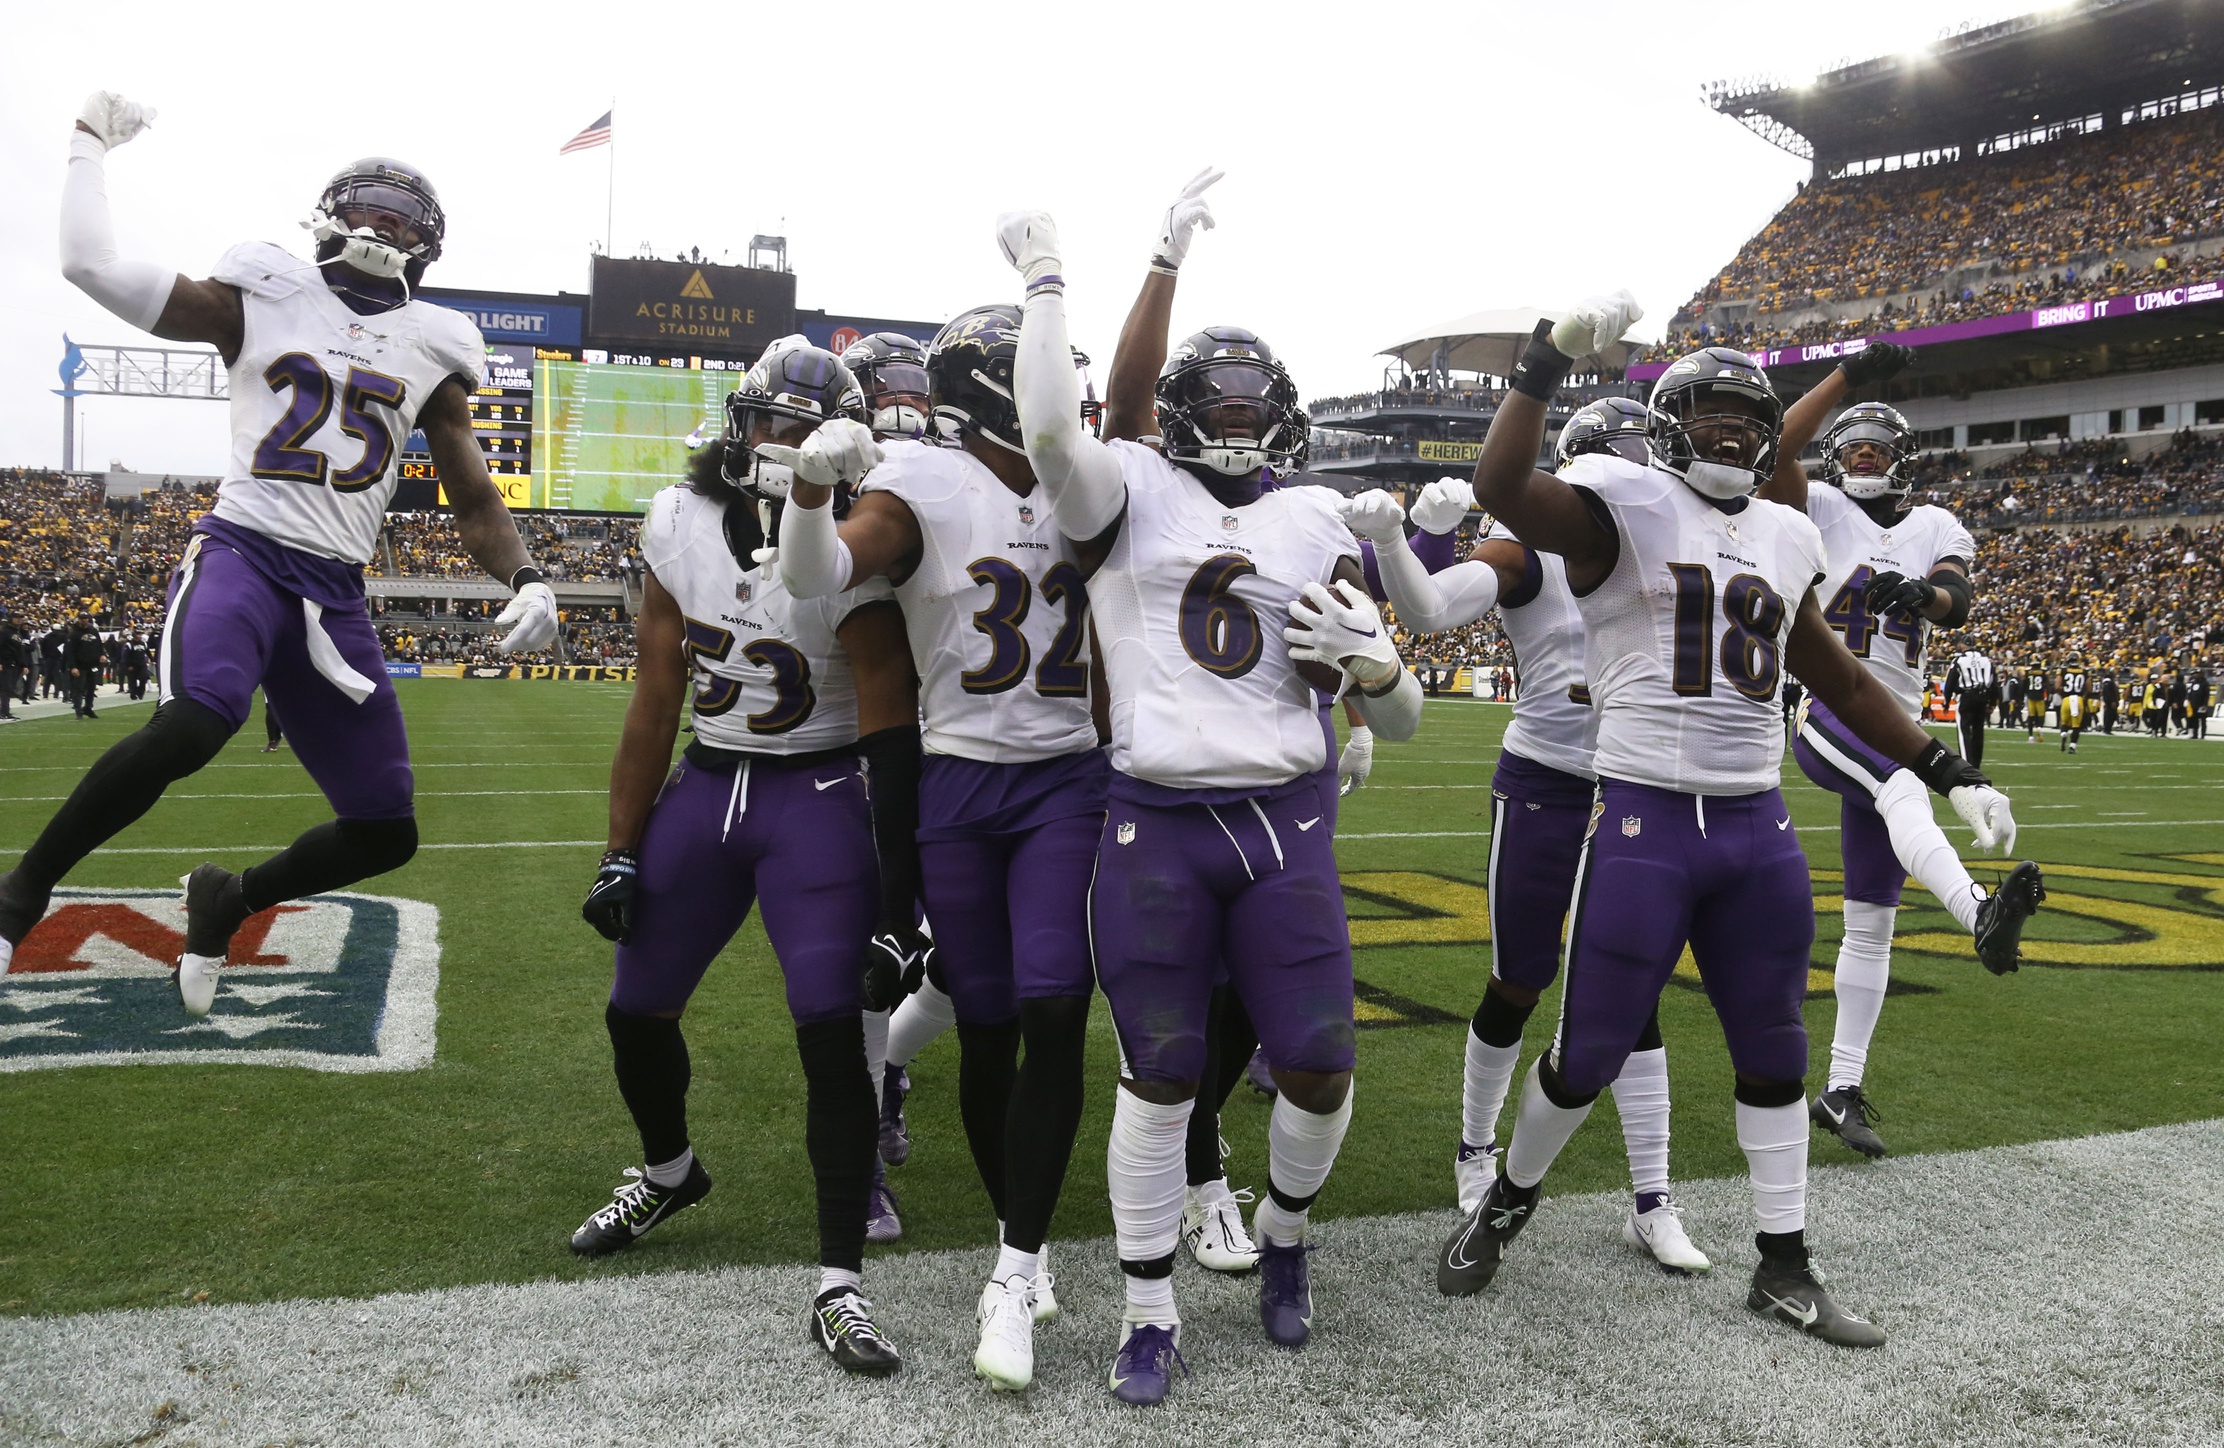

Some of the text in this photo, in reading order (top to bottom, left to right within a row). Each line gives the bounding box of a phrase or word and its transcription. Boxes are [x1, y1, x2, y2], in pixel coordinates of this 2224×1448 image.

[636, 302, 755, 324] ACRISURE
[2038, 288, 2183, 326] BRING IT UPMC
[481, 312, 544, 332] LIGHT
[659, 322, 730, 337] STADIUM
[835, 334, 858, 353] 84
[1802, 342, 1840, 361] UPMC
[328, 349, 371, 366] RAVENS
[536, 349, 571, 361] Steelers
[1769, 351, 1781, 365] IT
[671, 357, 684, 367] 23
[704, 360, 725, 370] 2ND
[728, 361, 745, 370] 0:21
[494, 368, 528, 378] GAME
[490, 377, 532, 388] LEADERS
[475, 388, 503, 397] ASSING
[251, 352, 406, 493] 25
[403, 463, 435, 478] 0:21
[1007, 541, 1049, 551] RAVENS
[1205, 543, 1252, 555] RAVENS
[1717, 552, 1757, 568] RAVENS
[1869, 556, 1900, 567] RAVENS
[720, 614, 763, 631] RAVENS
[1179, 554, 1264, 679] 6
[1823, 564, 1924, 669] 44
[961, 556, 1090, 698] 32
[1666, 561, 1785, 702] 18
[404, 667, 418, 675] NFL
[684, 615, 816, 735] 53
[2028, 675, 2043, 691] 18
[2063, 673, 2085, 693] 30
[2132, 685, 2143, 697] 83
